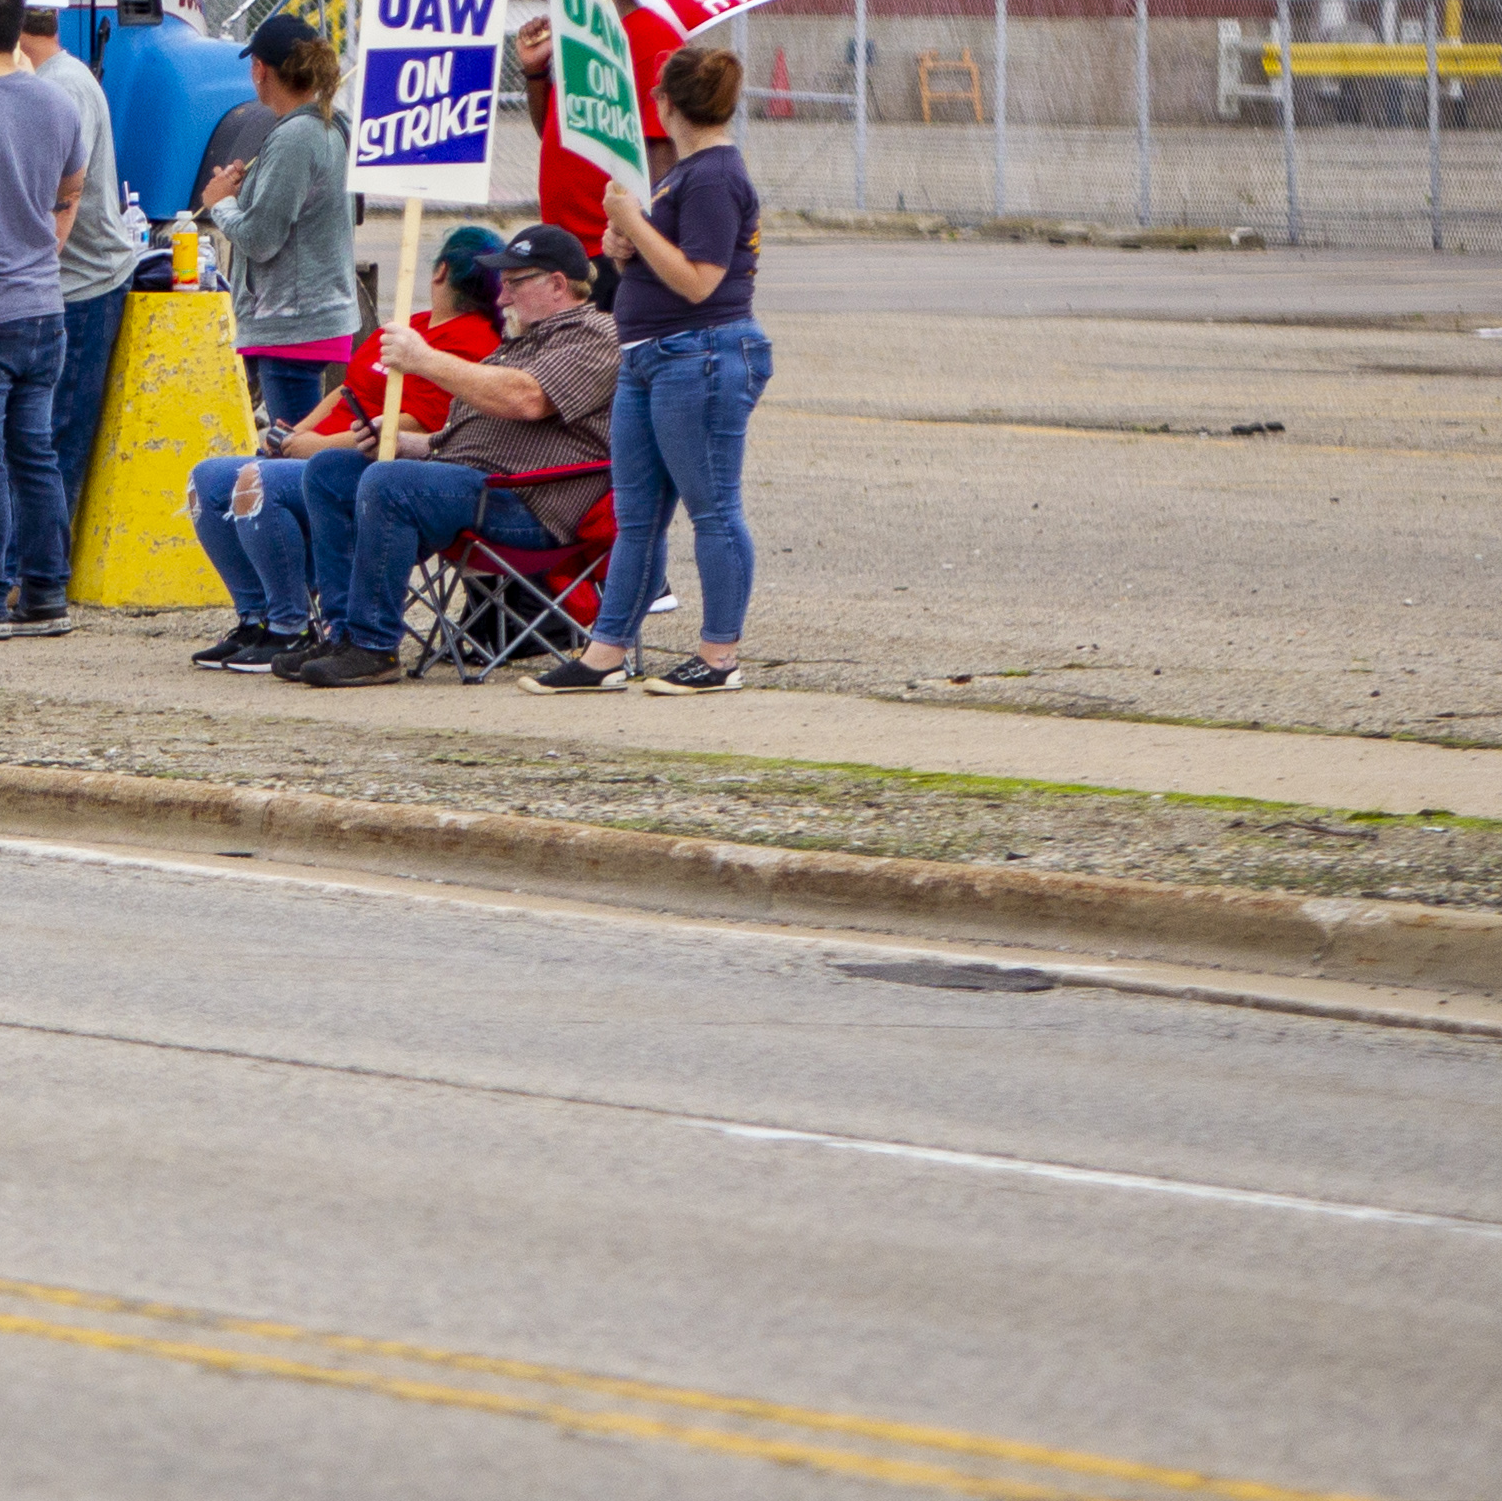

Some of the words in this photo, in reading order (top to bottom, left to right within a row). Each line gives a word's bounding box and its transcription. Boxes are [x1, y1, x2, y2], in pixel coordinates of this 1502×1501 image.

[398, 50, 454, 104] ON
[587, 57, 620, 102] ON
[357, 89, 493, 162] STRIKE
